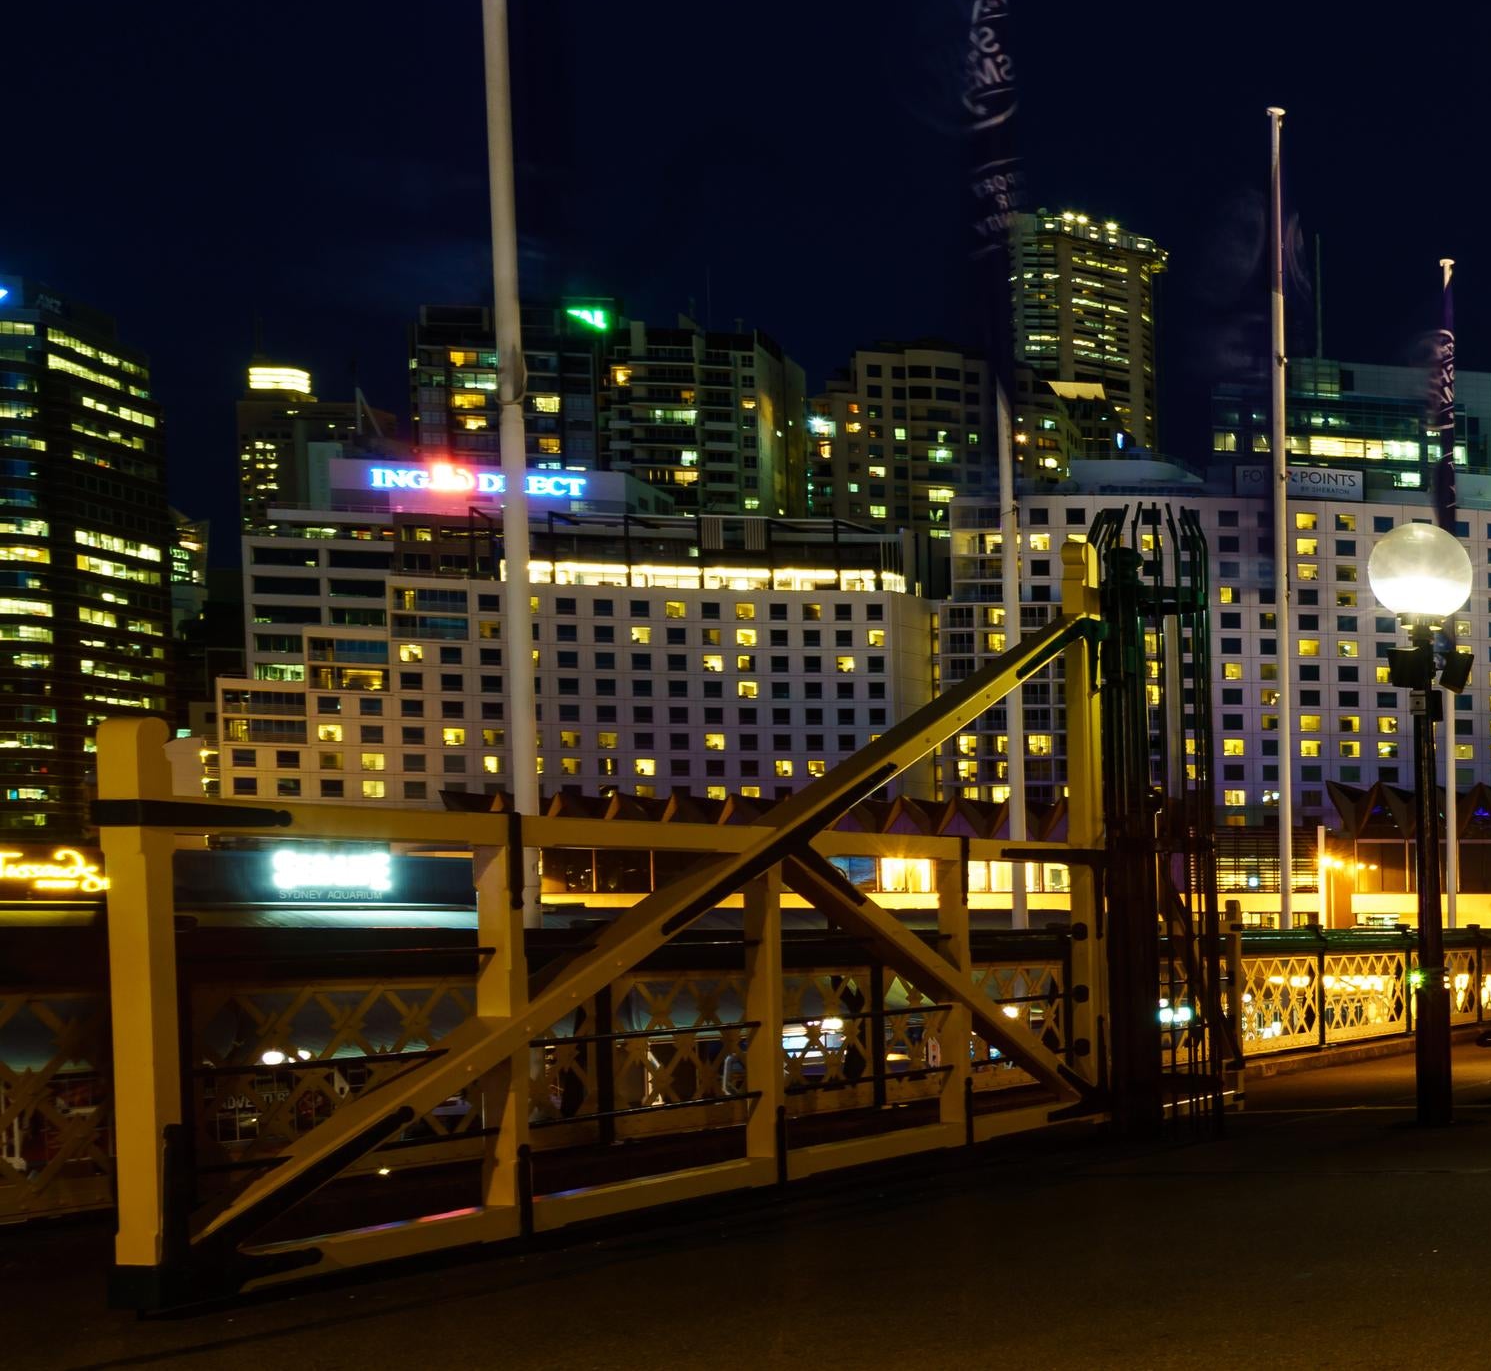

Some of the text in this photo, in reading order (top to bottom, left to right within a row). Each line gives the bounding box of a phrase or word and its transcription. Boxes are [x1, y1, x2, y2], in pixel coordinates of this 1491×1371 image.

[370, 468, 586, 496] ING DIECT
[1300, 471, 1356, 487] POINTS
[280, 890, 382, 899] SYDNEY AQUARIUM
